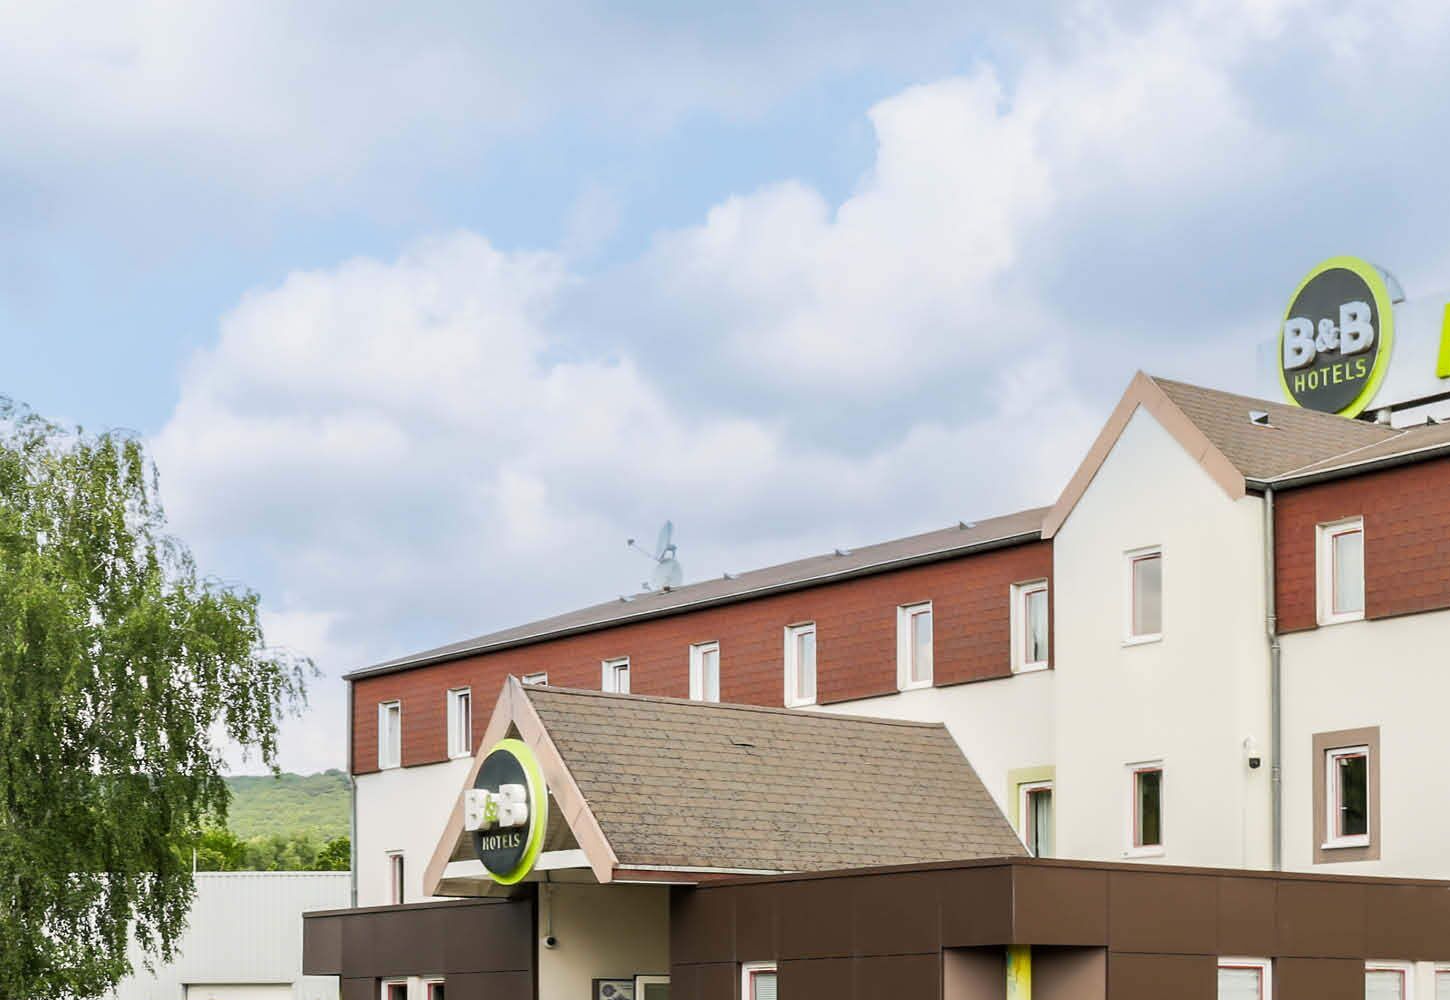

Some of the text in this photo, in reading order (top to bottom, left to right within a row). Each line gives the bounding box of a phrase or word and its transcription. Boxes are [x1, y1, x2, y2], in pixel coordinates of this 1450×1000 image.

[1284, 300, 1374, 370] B&B
[1294, 358, 1367, 393] HOTELS
[464, 783, 528, 831] B&B
[482, 833, 520, 850] HOTELS
